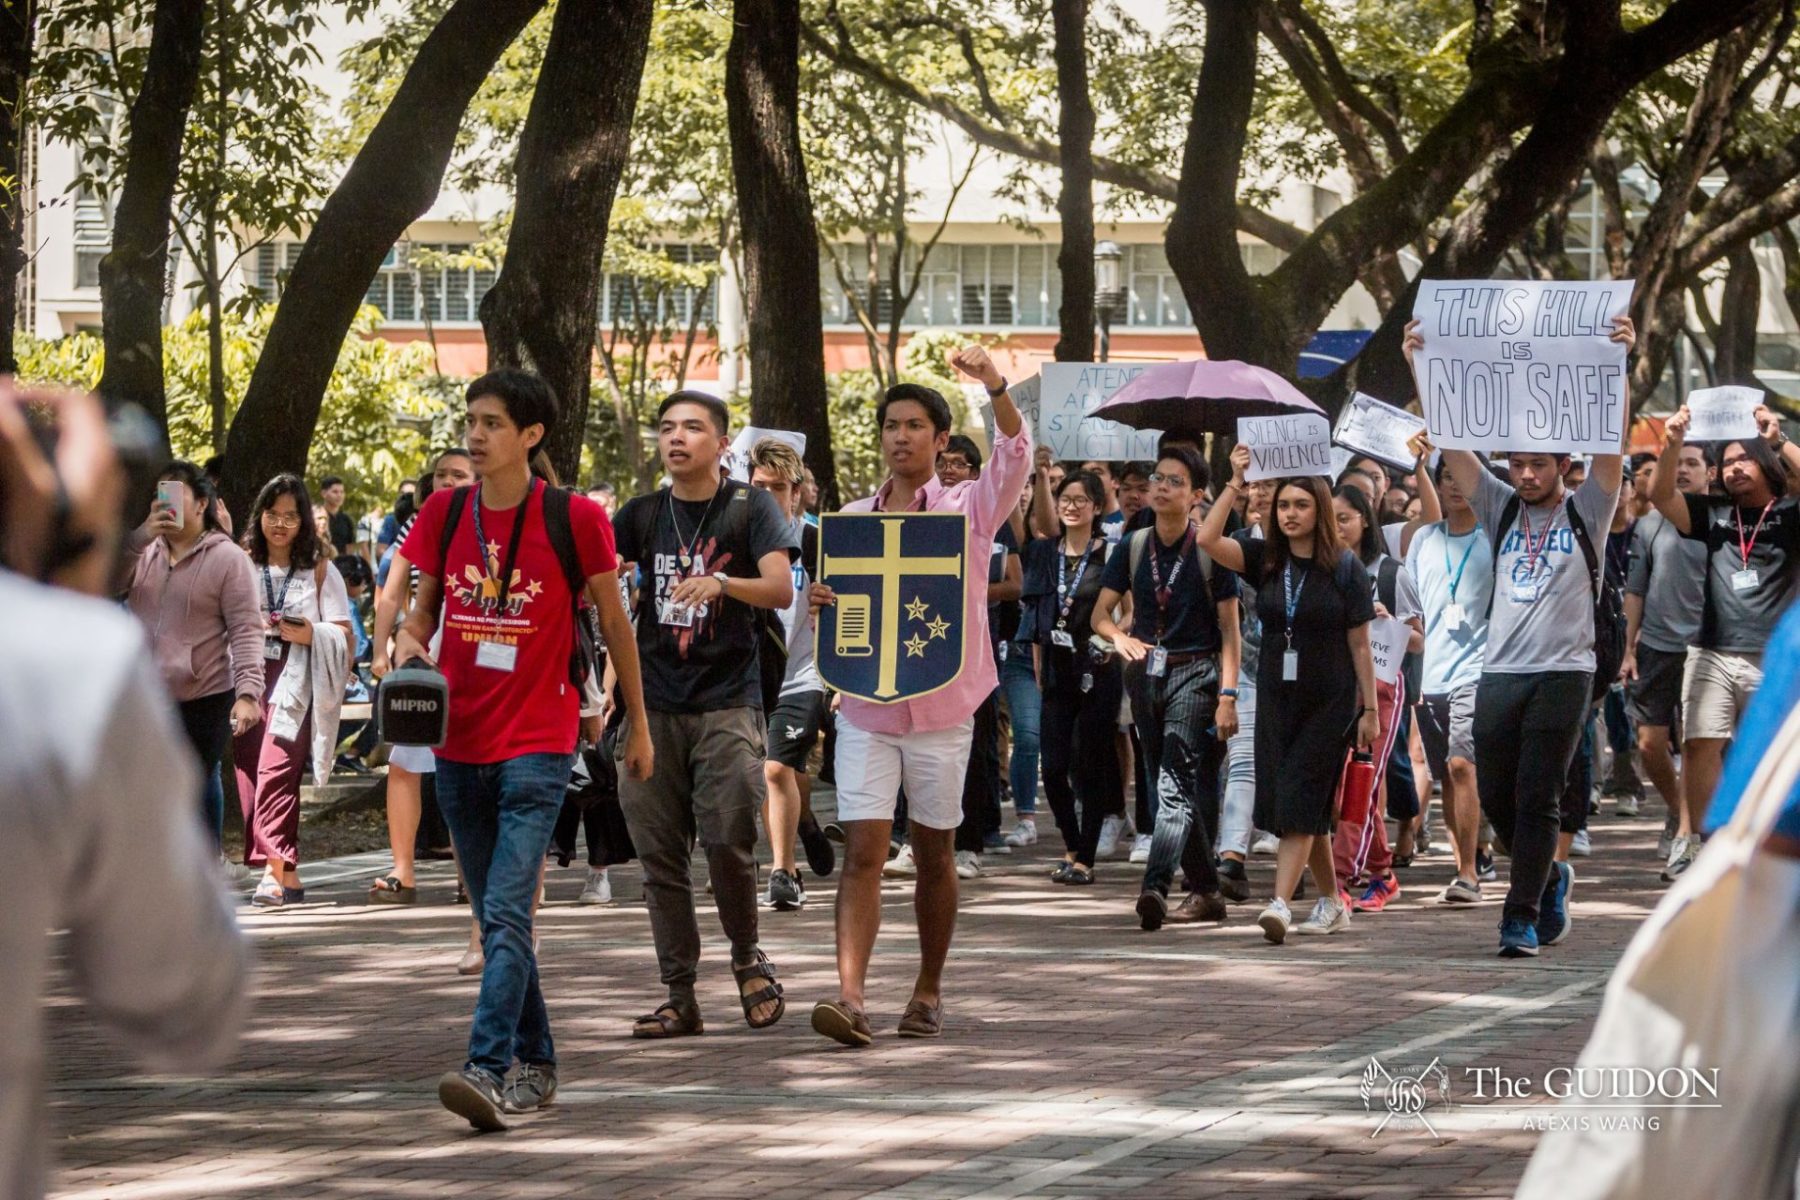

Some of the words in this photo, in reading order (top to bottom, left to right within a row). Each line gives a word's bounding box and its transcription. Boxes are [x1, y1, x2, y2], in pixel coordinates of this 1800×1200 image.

[1434, 288, 1530, 337] THIS
[1534, 290, 1615, 337] HILL
[1501, 341, 1533, 360] IS
[1429, 358, 1514, 438] NOT
[1527, 363, 1620, 442] SAFE
[1247, 419, 1302, 446] SILENCE
[1307, 424, 1319, 436] IS
[1252, 441, 1331, 472] VIOLENCE
[1500, 528, 1573, 555] ATEEO
[654, 553, 705, 575] DEA
